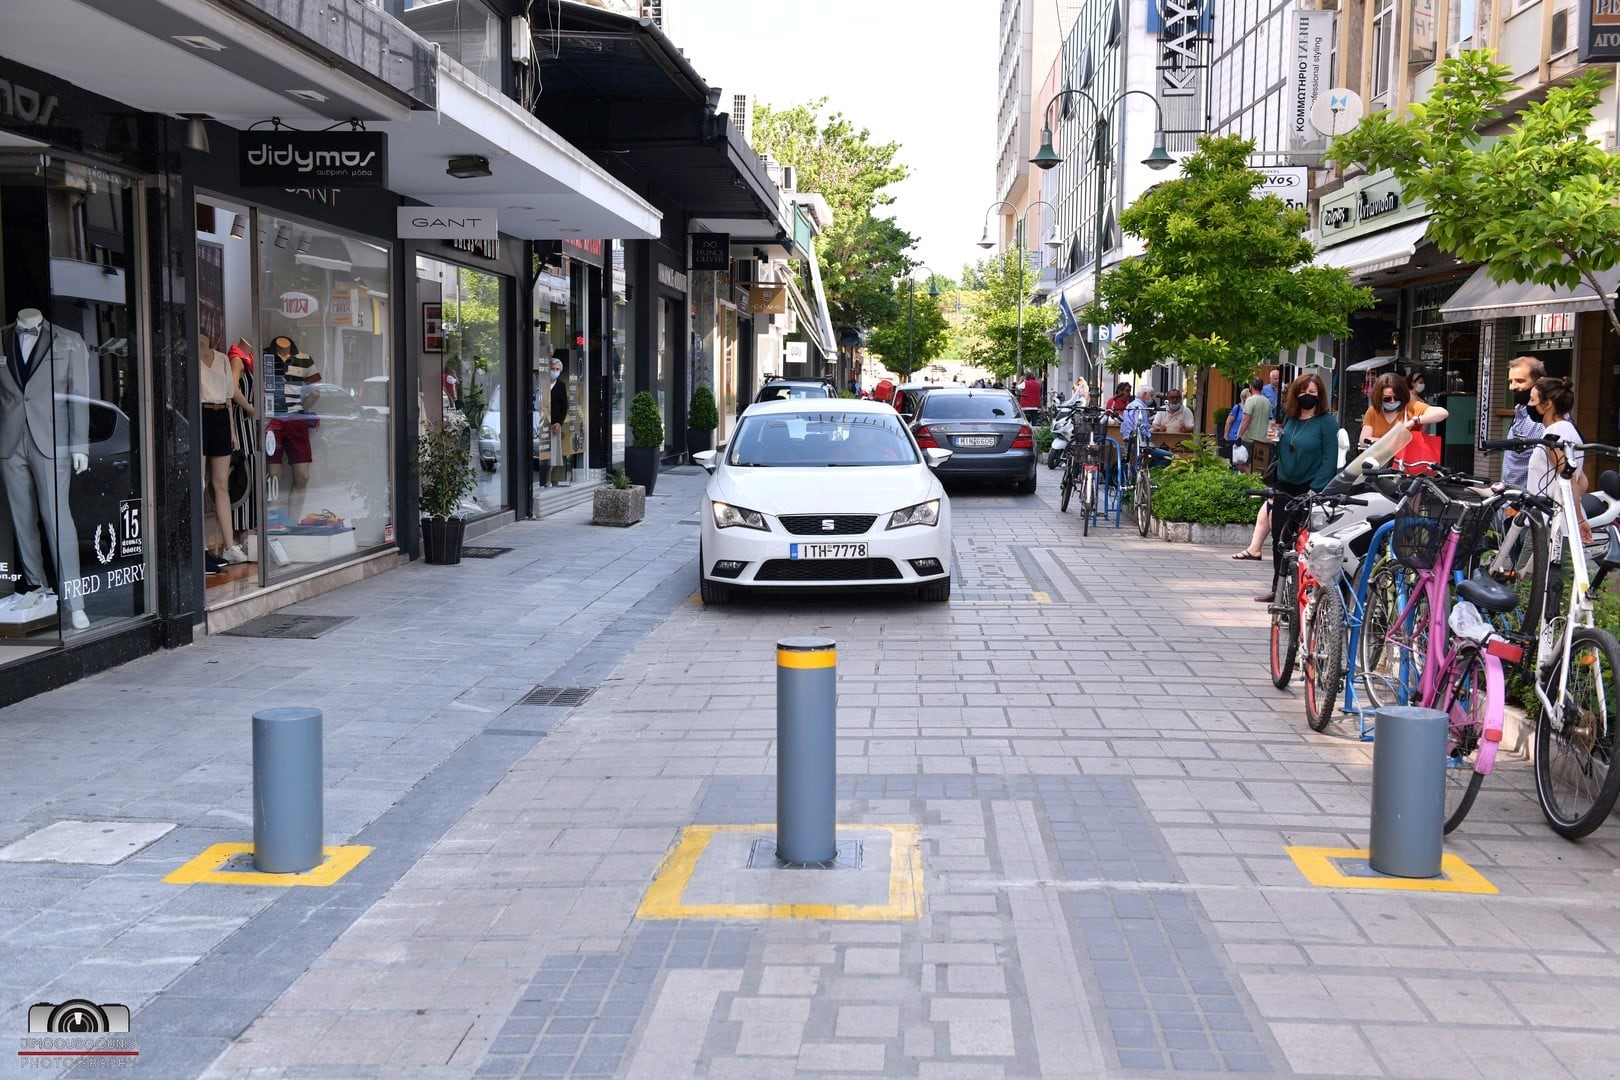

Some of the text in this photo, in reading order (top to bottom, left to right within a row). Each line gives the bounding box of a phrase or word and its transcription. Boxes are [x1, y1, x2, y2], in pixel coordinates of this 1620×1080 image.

[1313, 36, 1323, 62] styling
[1296, 61, 1308, 132] ΚΟΜΜΩΤΗΡΙΟ
[247, 143, 376, 172] didymos
[411, 217, 483, 229] GANT
[266, 474, 280, 502] 10
[123, 508, 140, 539] 15
[803, 543, 867, 559] ITH-7778
[63, 562, 147, 601] FRED PERRY
